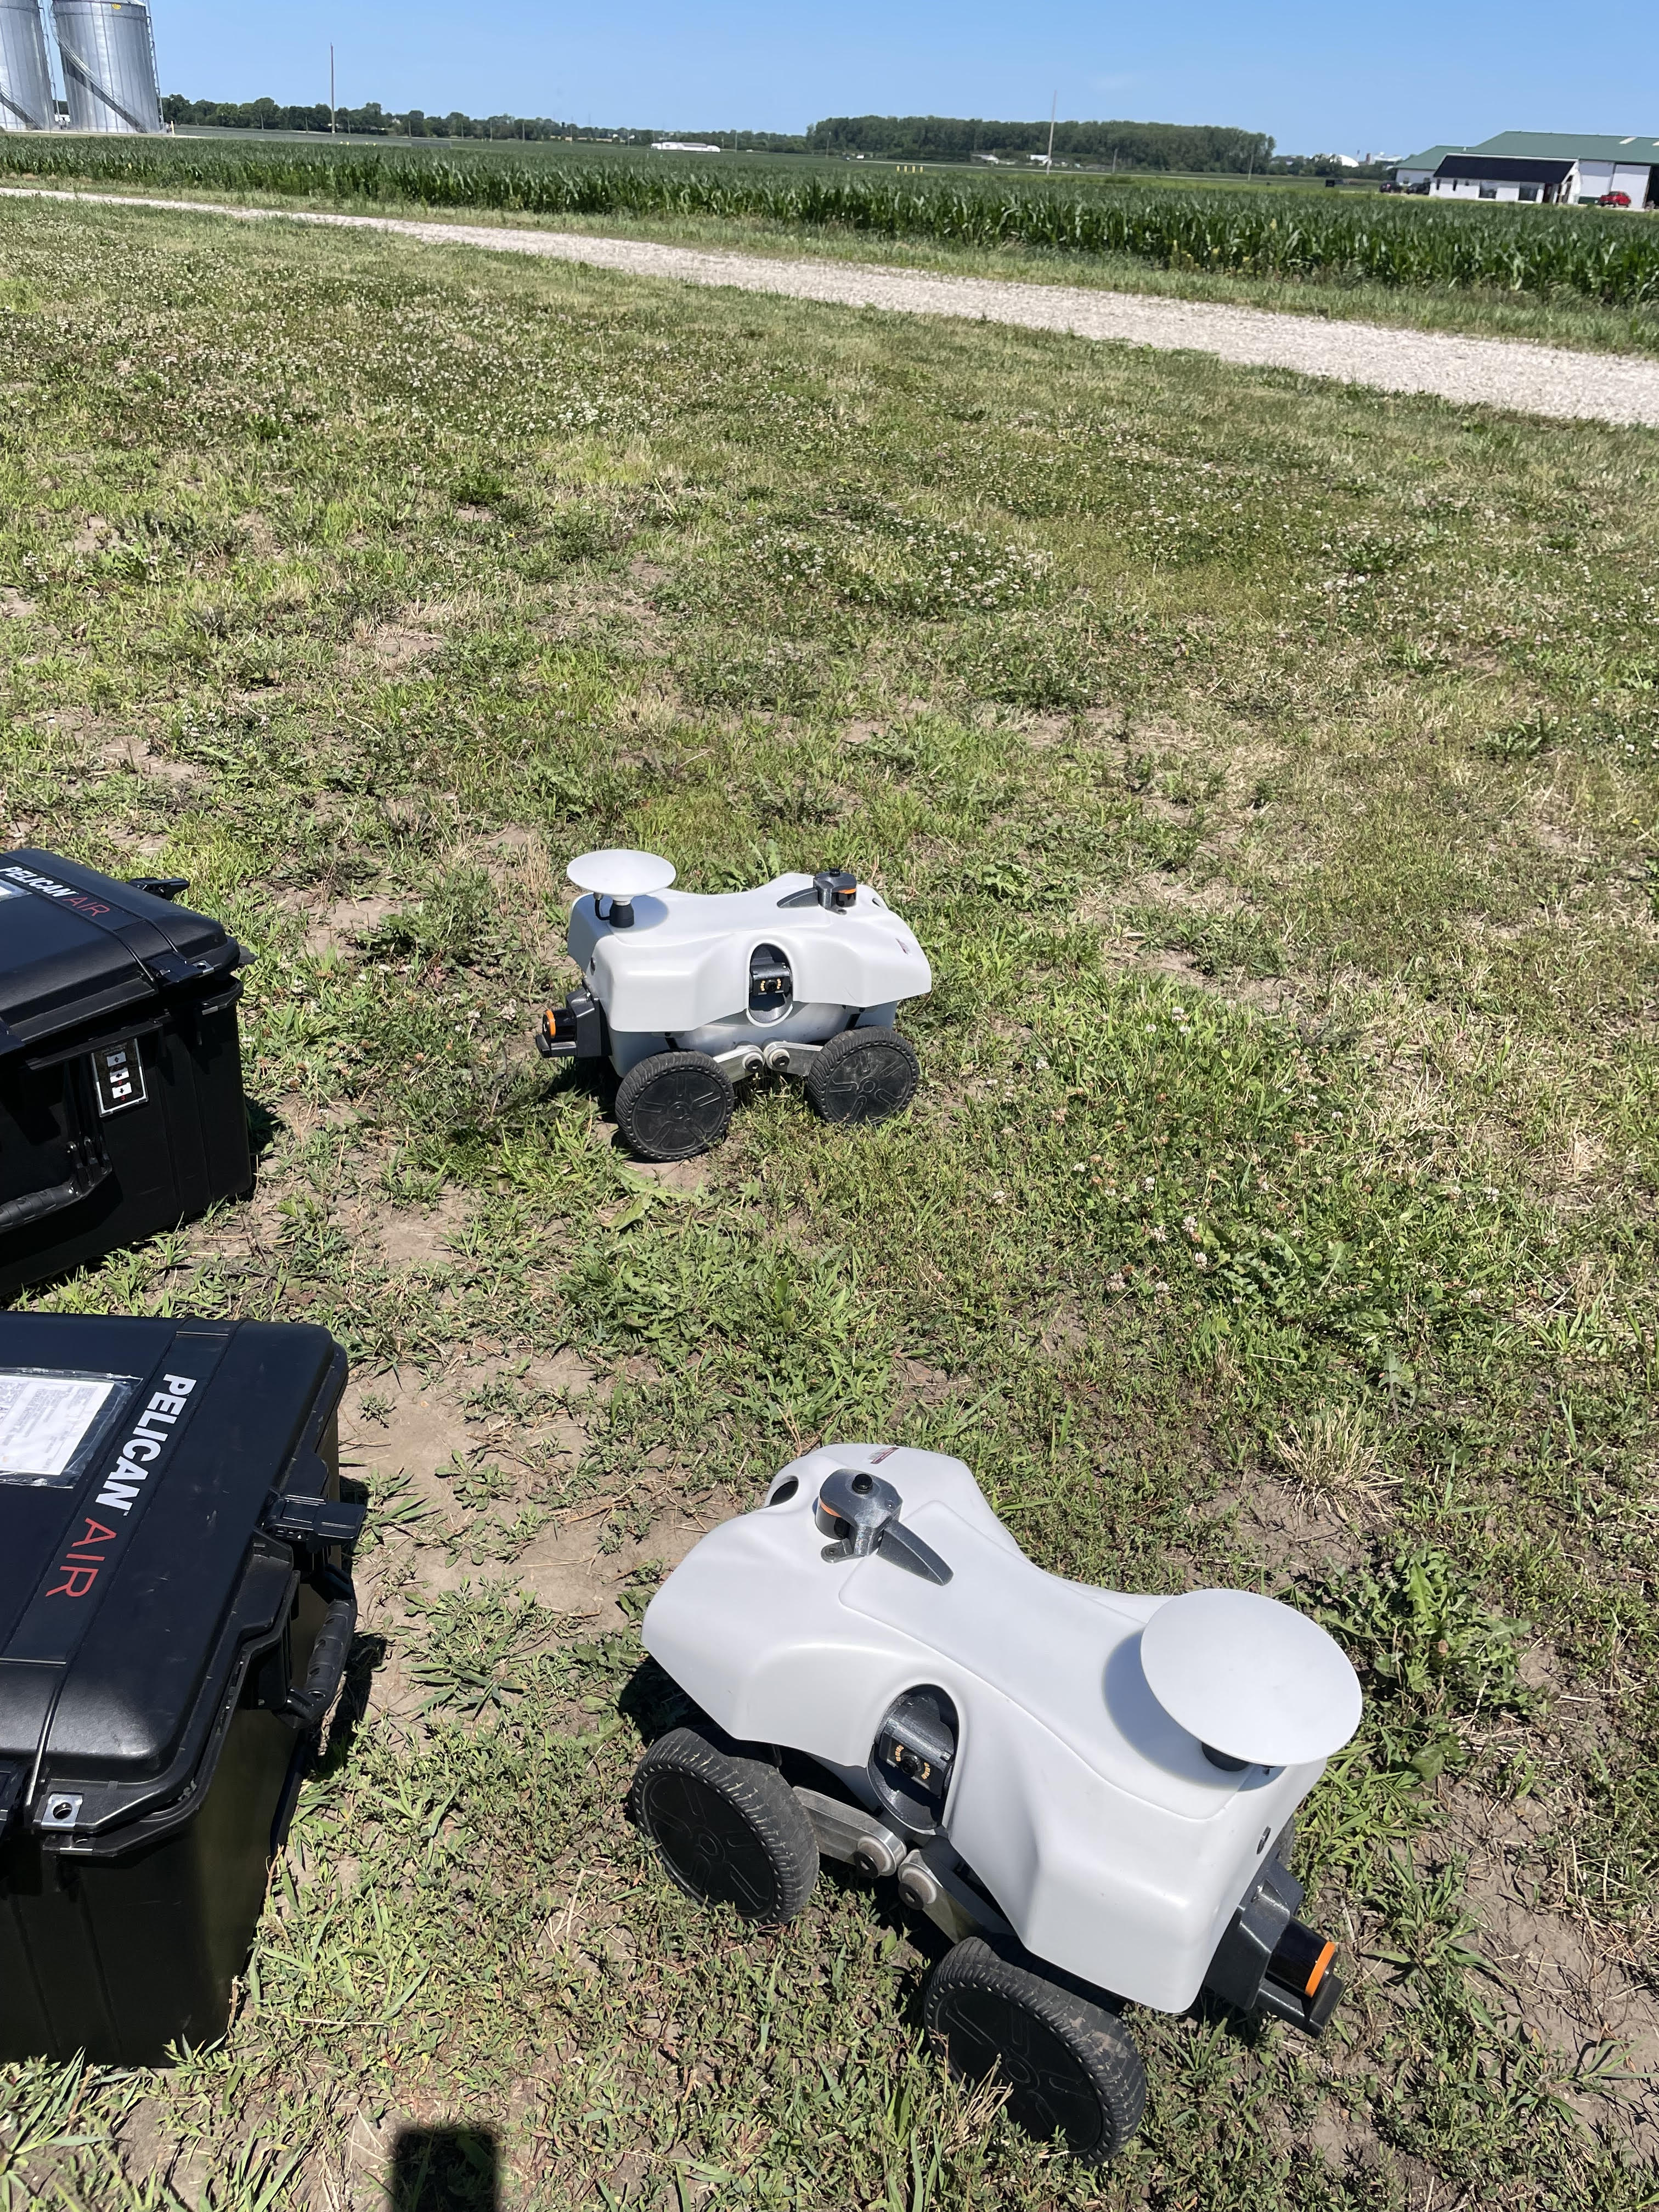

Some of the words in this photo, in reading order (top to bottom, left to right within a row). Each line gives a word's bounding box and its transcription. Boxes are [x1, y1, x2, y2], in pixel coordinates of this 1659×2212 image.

[0, 866, 77, 897] PELICAN
[61, 896, 110, 917] AIR
[95, 1374, 197, 1511] PELICAN
[45, 1517, 117, 1598] AIR
